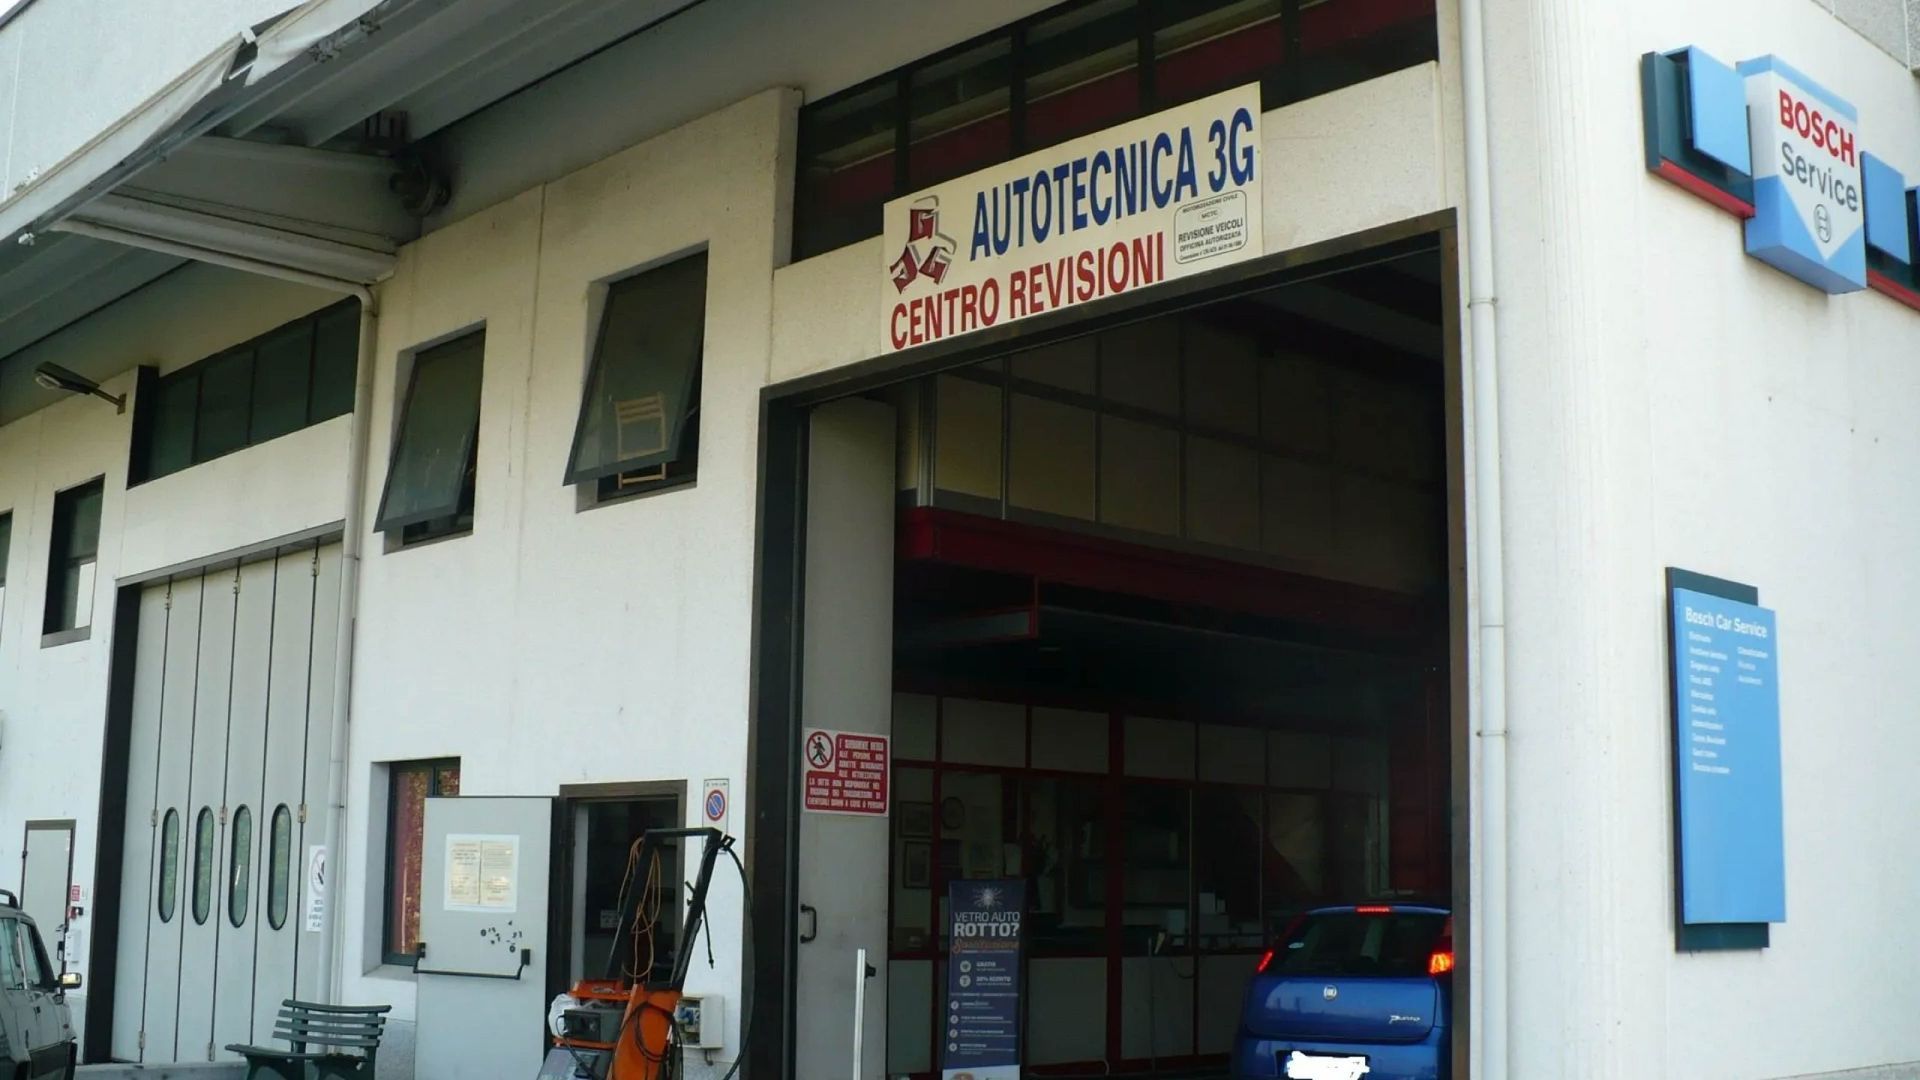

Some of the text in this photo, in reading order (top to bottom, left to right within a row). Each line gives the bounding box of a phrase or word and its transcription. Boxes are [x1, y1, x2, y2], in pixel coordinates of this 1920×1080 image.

[1779, 89, 1855, 168] BOSCH
[970, 107, 1255, 262] AUTOTECNICA 3G
[1781, 141, 1858, 213] Service
[1178, 218, 1244, 243] REVISIONE VEICOLI
[1180, 240, 1204, 252] OFFICINA
[1205, 231, 1242, 245] AUTORIZZATA
[891, 231, 1165, 351] CENTRO REVISIONI
[1685, 606, 1715, 629] Bosch
[1716, 613, 1732, 632] Car
[1733, 618, 1768, 639] Service
[954, 922, 1020, 938] ROTTO?
[955, 911, 1021, 923] VETRO AUTO
